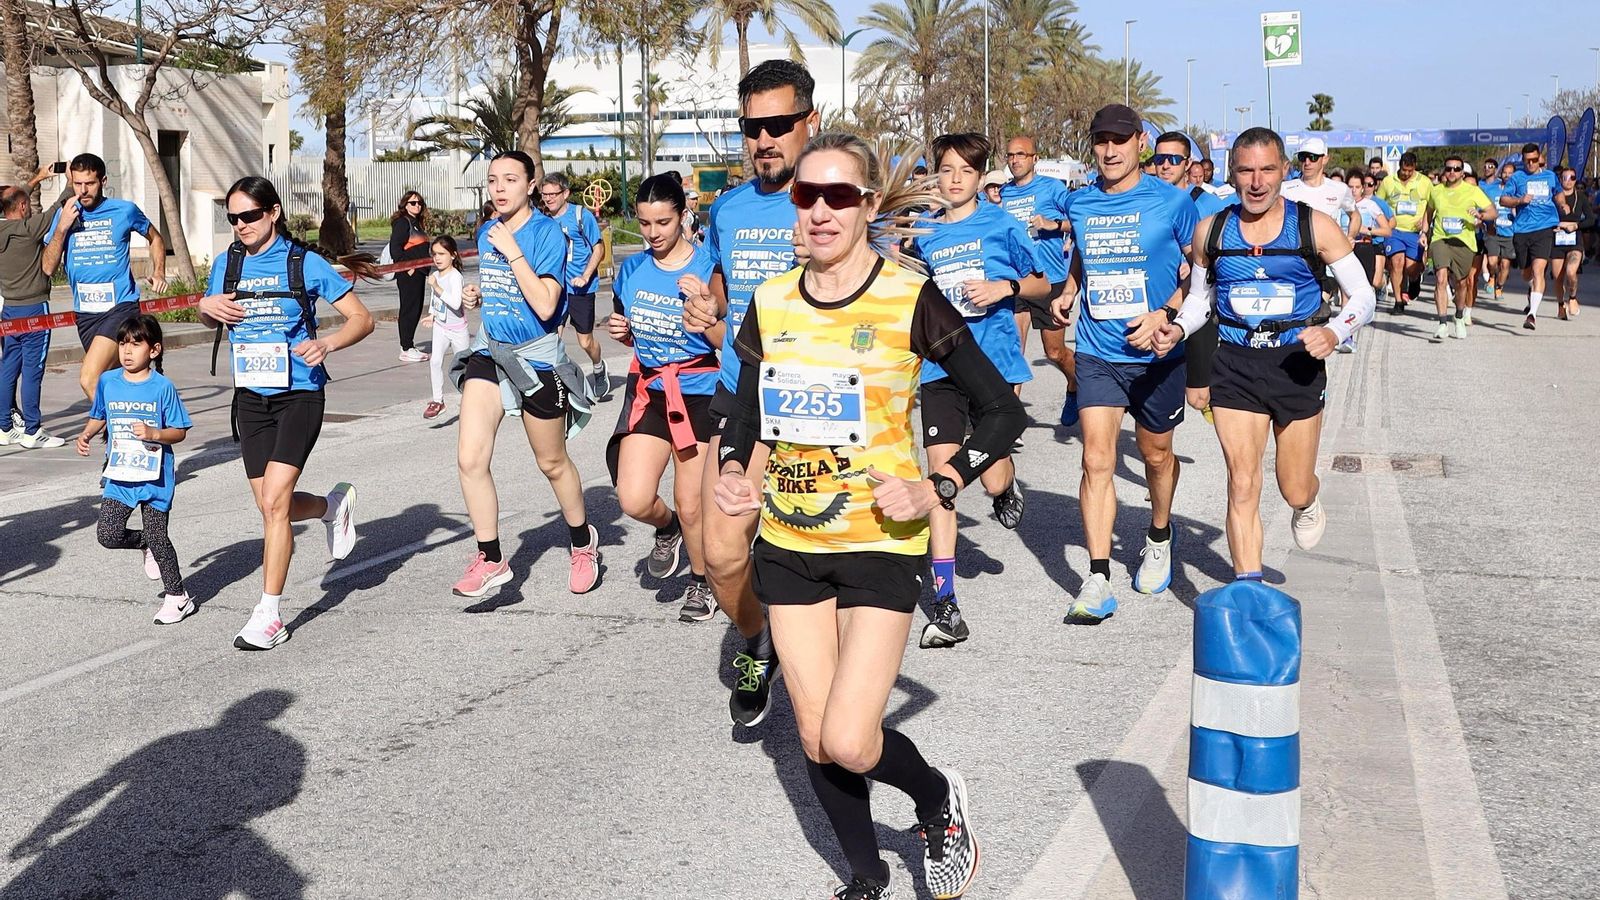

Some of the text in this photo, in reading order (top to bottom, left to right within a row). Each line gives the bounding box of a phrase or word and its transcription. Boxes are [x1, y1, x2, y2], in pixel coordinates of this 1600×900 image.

[1374, 133, 1412, 143] mayoral
[81, 219, 112, 229] ayoral
[1087, 212, 1140, 227] mayoral
[736, 228, 794, 243] mayora
[731, 250, 795, 261] RUNNING
[932, 238, 981, 261] mayoral
[736, 260, 788, 271] MAKES
[84, 294, 107, 302] 2462
[636, 290, 684, 308] mayora
[1098, 288, 1134, 303] 2469
[1251, 298, 1272, 312] 47
[245, 356, 277, 371] 2928
[777, 371, 801, 379] Carrera
[832, 371, 860, 380] mayol
[777, 378, 806, 386] Solidaria
[108, 401, 157, 413] mayoral
[778, 390, 843, 416] 2255
[765, 417, 781, 425] 5KM
[777, 477, 818, 494] BIKE
